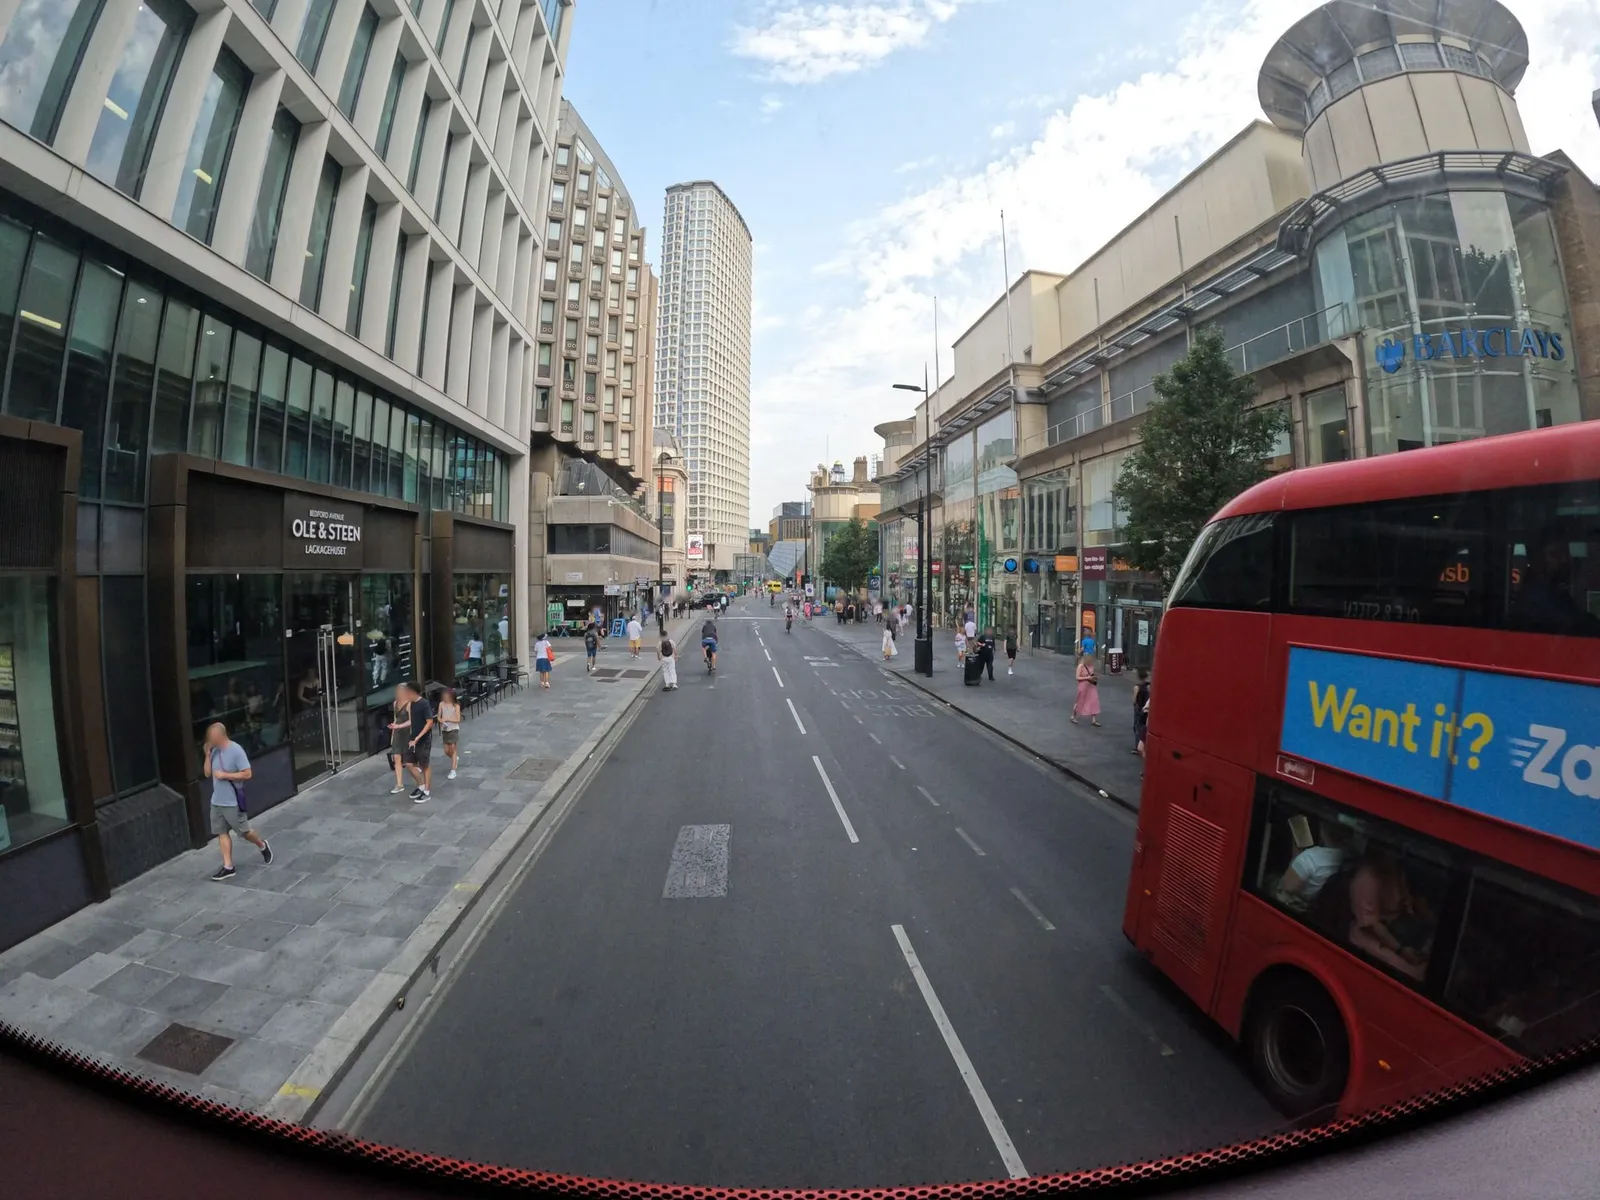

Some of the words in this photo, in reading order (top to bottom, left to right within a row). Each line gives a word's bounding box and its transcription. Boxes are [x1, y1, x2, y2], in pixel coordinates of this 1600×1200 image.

[1413, 326, 1565, 361] BARCLAYS
[309, 509, 328, 519] BEDFORD
[329, 512, 345, 521] AVENUE
[292, 518, 317, 538] OLE
[318, 521, 327, 539] &
[328, 523, 361, 542] STEEN
[1308, 680, 1421, 753] Want
[1430, 703, 1494, 770] it?
